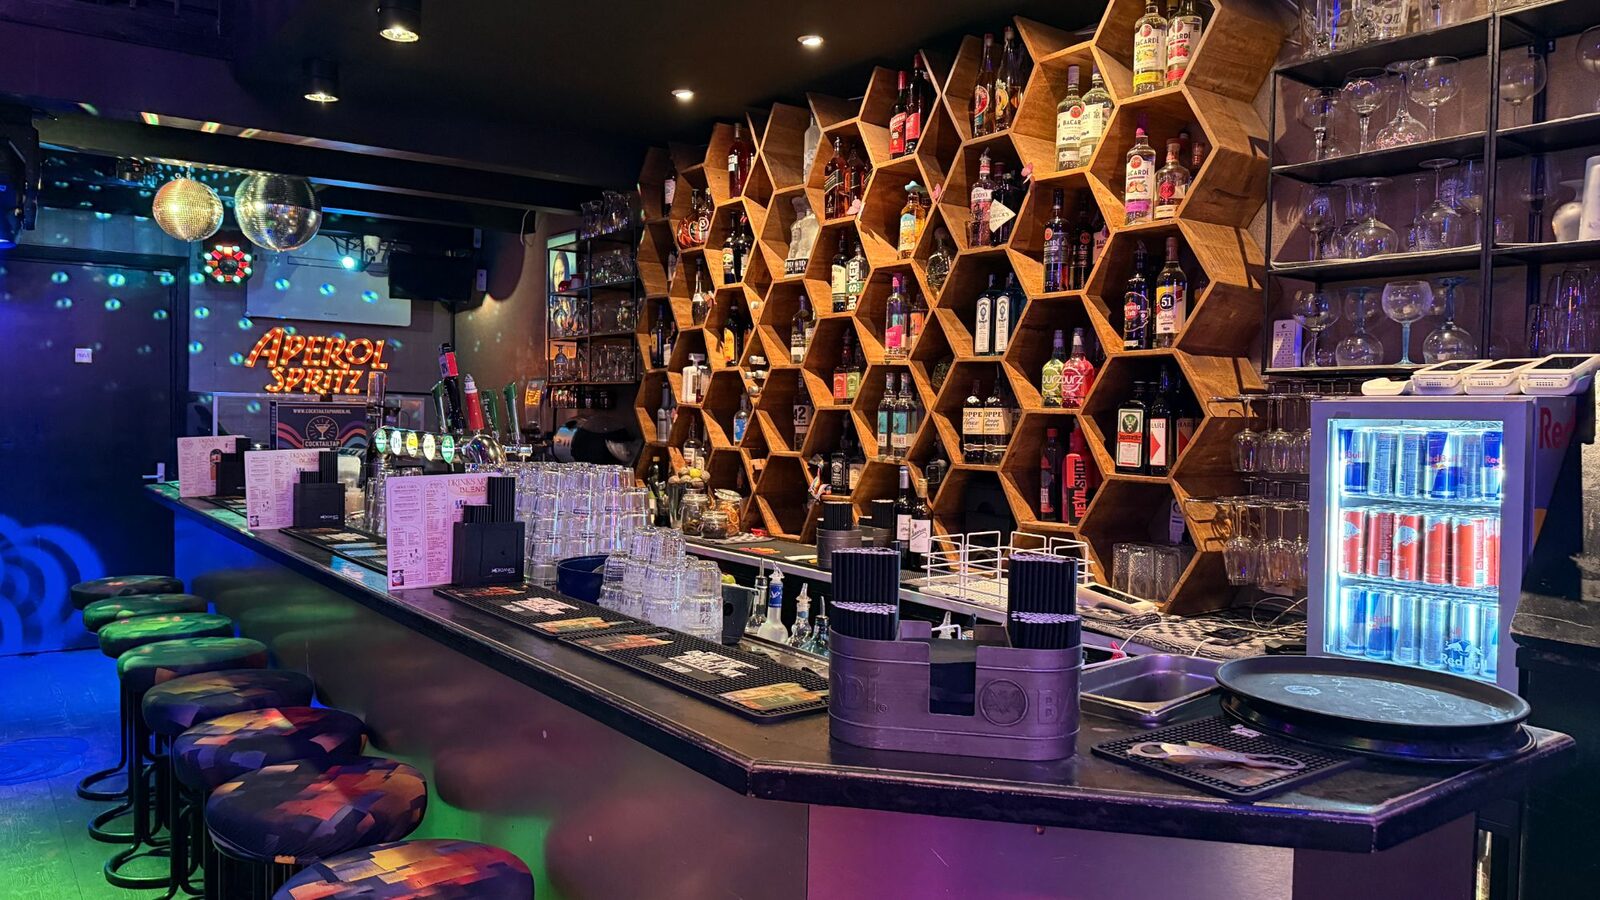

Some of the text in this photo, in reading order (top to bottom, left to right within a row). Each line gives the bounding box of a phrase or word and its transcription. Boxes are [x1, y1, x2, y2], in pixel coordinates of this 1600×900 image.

[1161, 296, 1173, 307] 51
[244, 327, 389, 369] APEROL
[265, 366, 364, 396] SPRITZ
[304, 440, 340, 448] COCKTAILTAP
[1072, 458, 1086, 518] DEVILSHOT
[1440, 653, 1463, 667] Red
